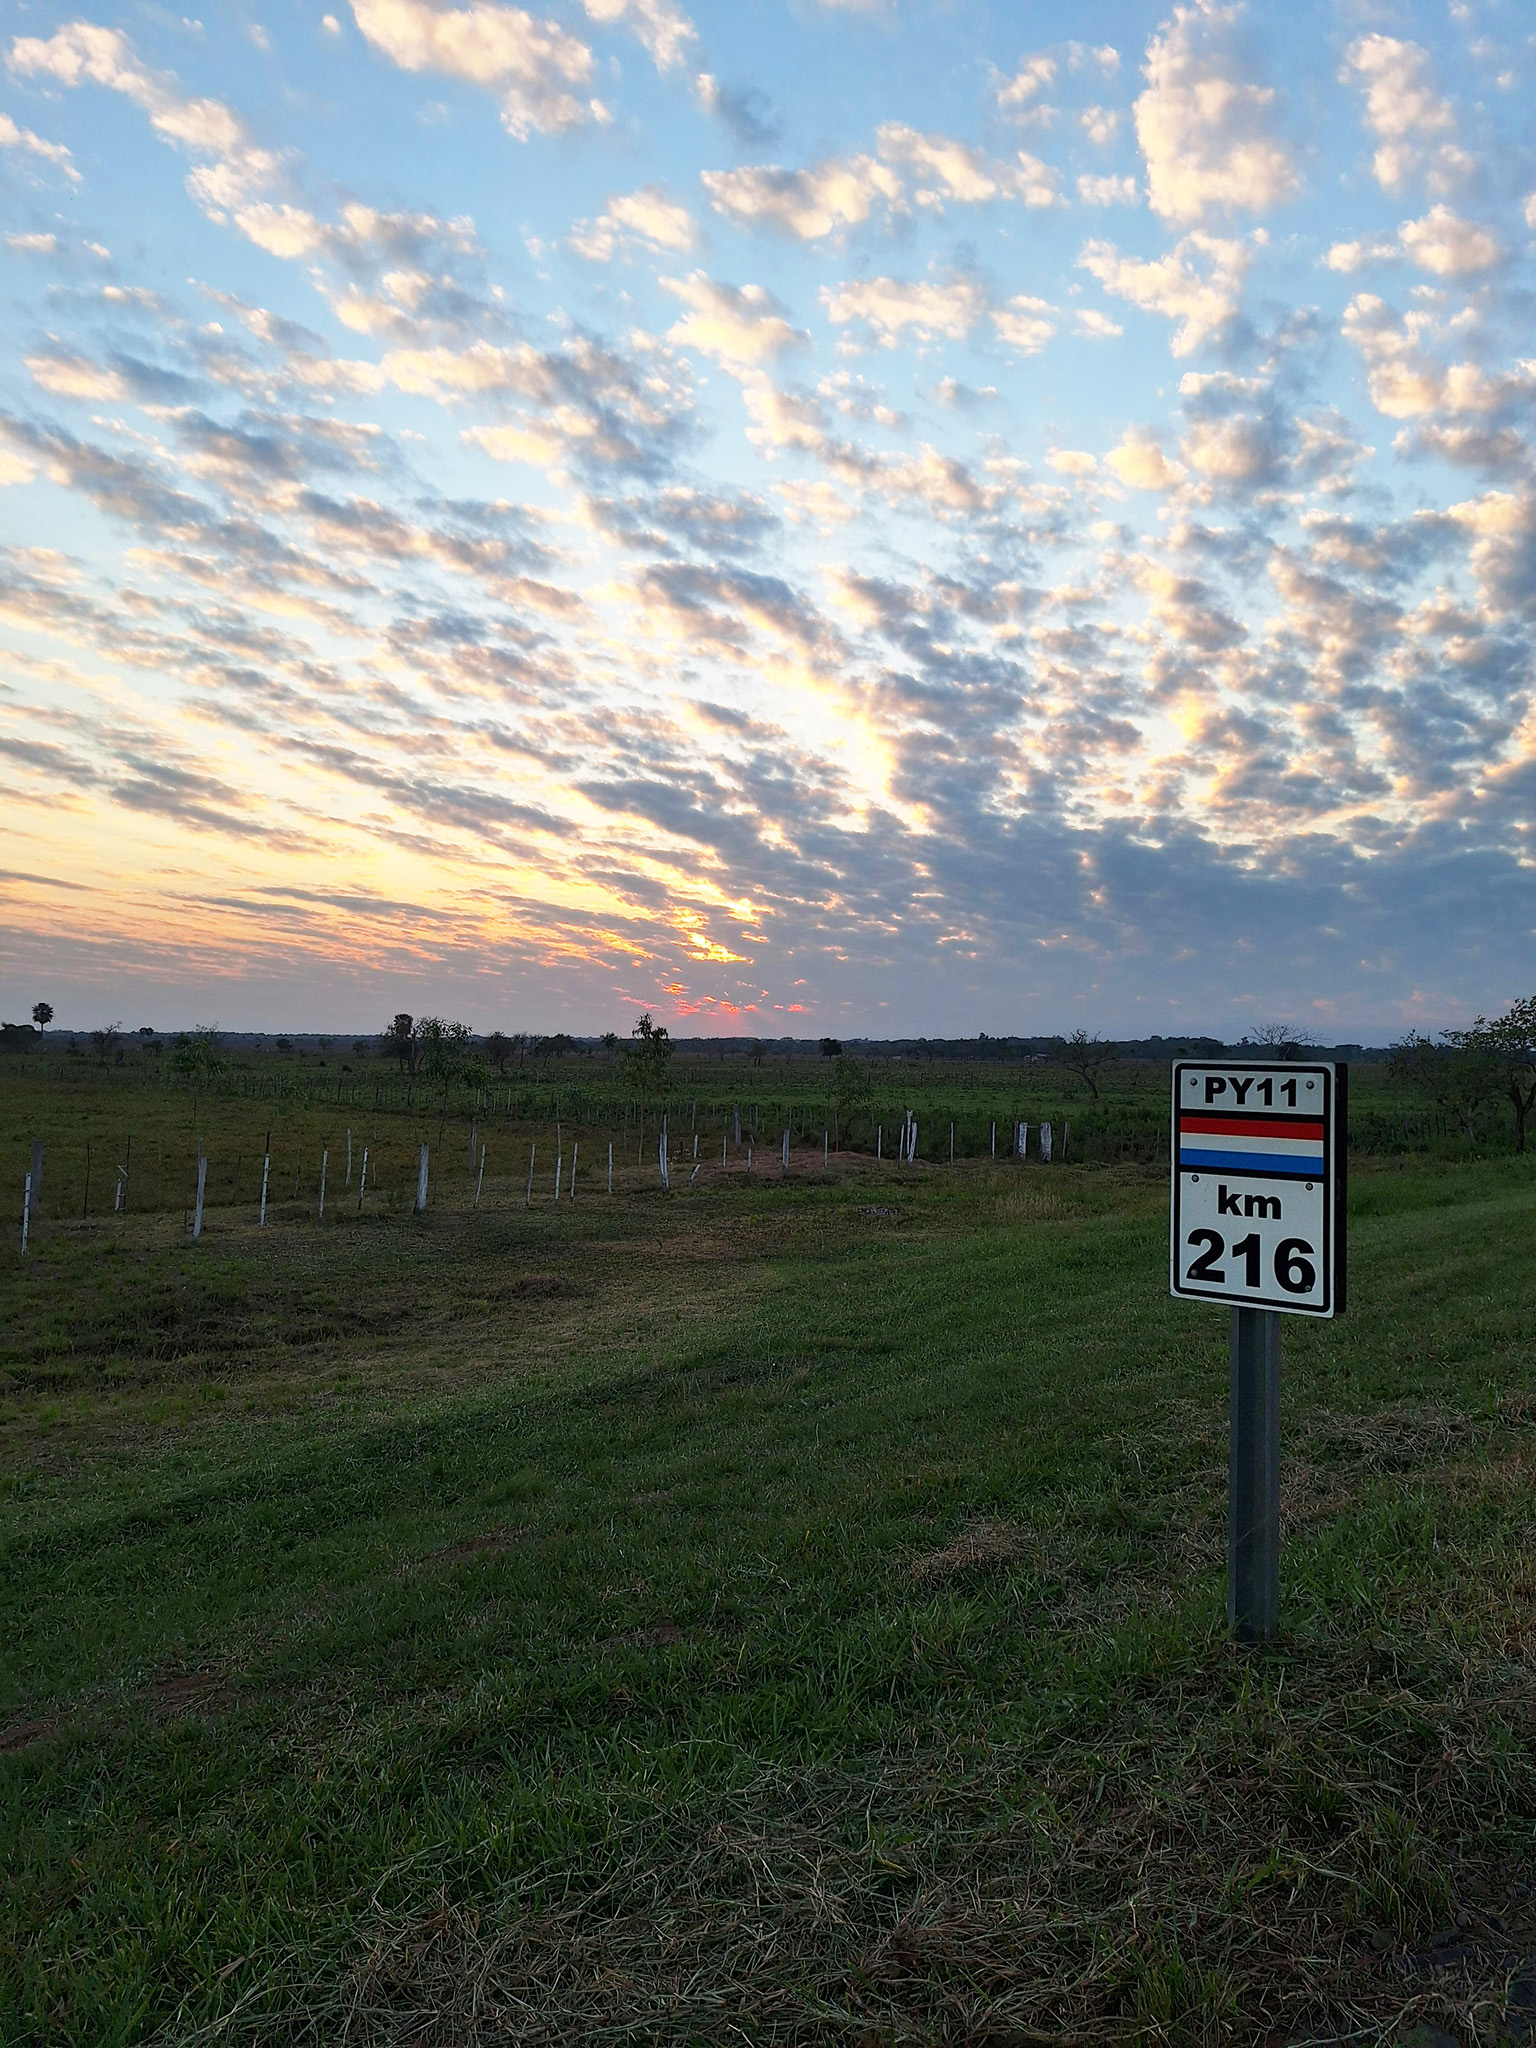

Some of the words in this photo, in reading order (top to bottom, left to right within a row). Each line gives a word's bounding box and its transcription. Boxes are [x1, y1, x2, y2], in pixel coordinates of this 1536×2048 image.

[1205, 1076, 1297, 1107] PY11
[1217, 1184, 1282, 1220] km
[1186, 1228, 1316, 1294] 216
